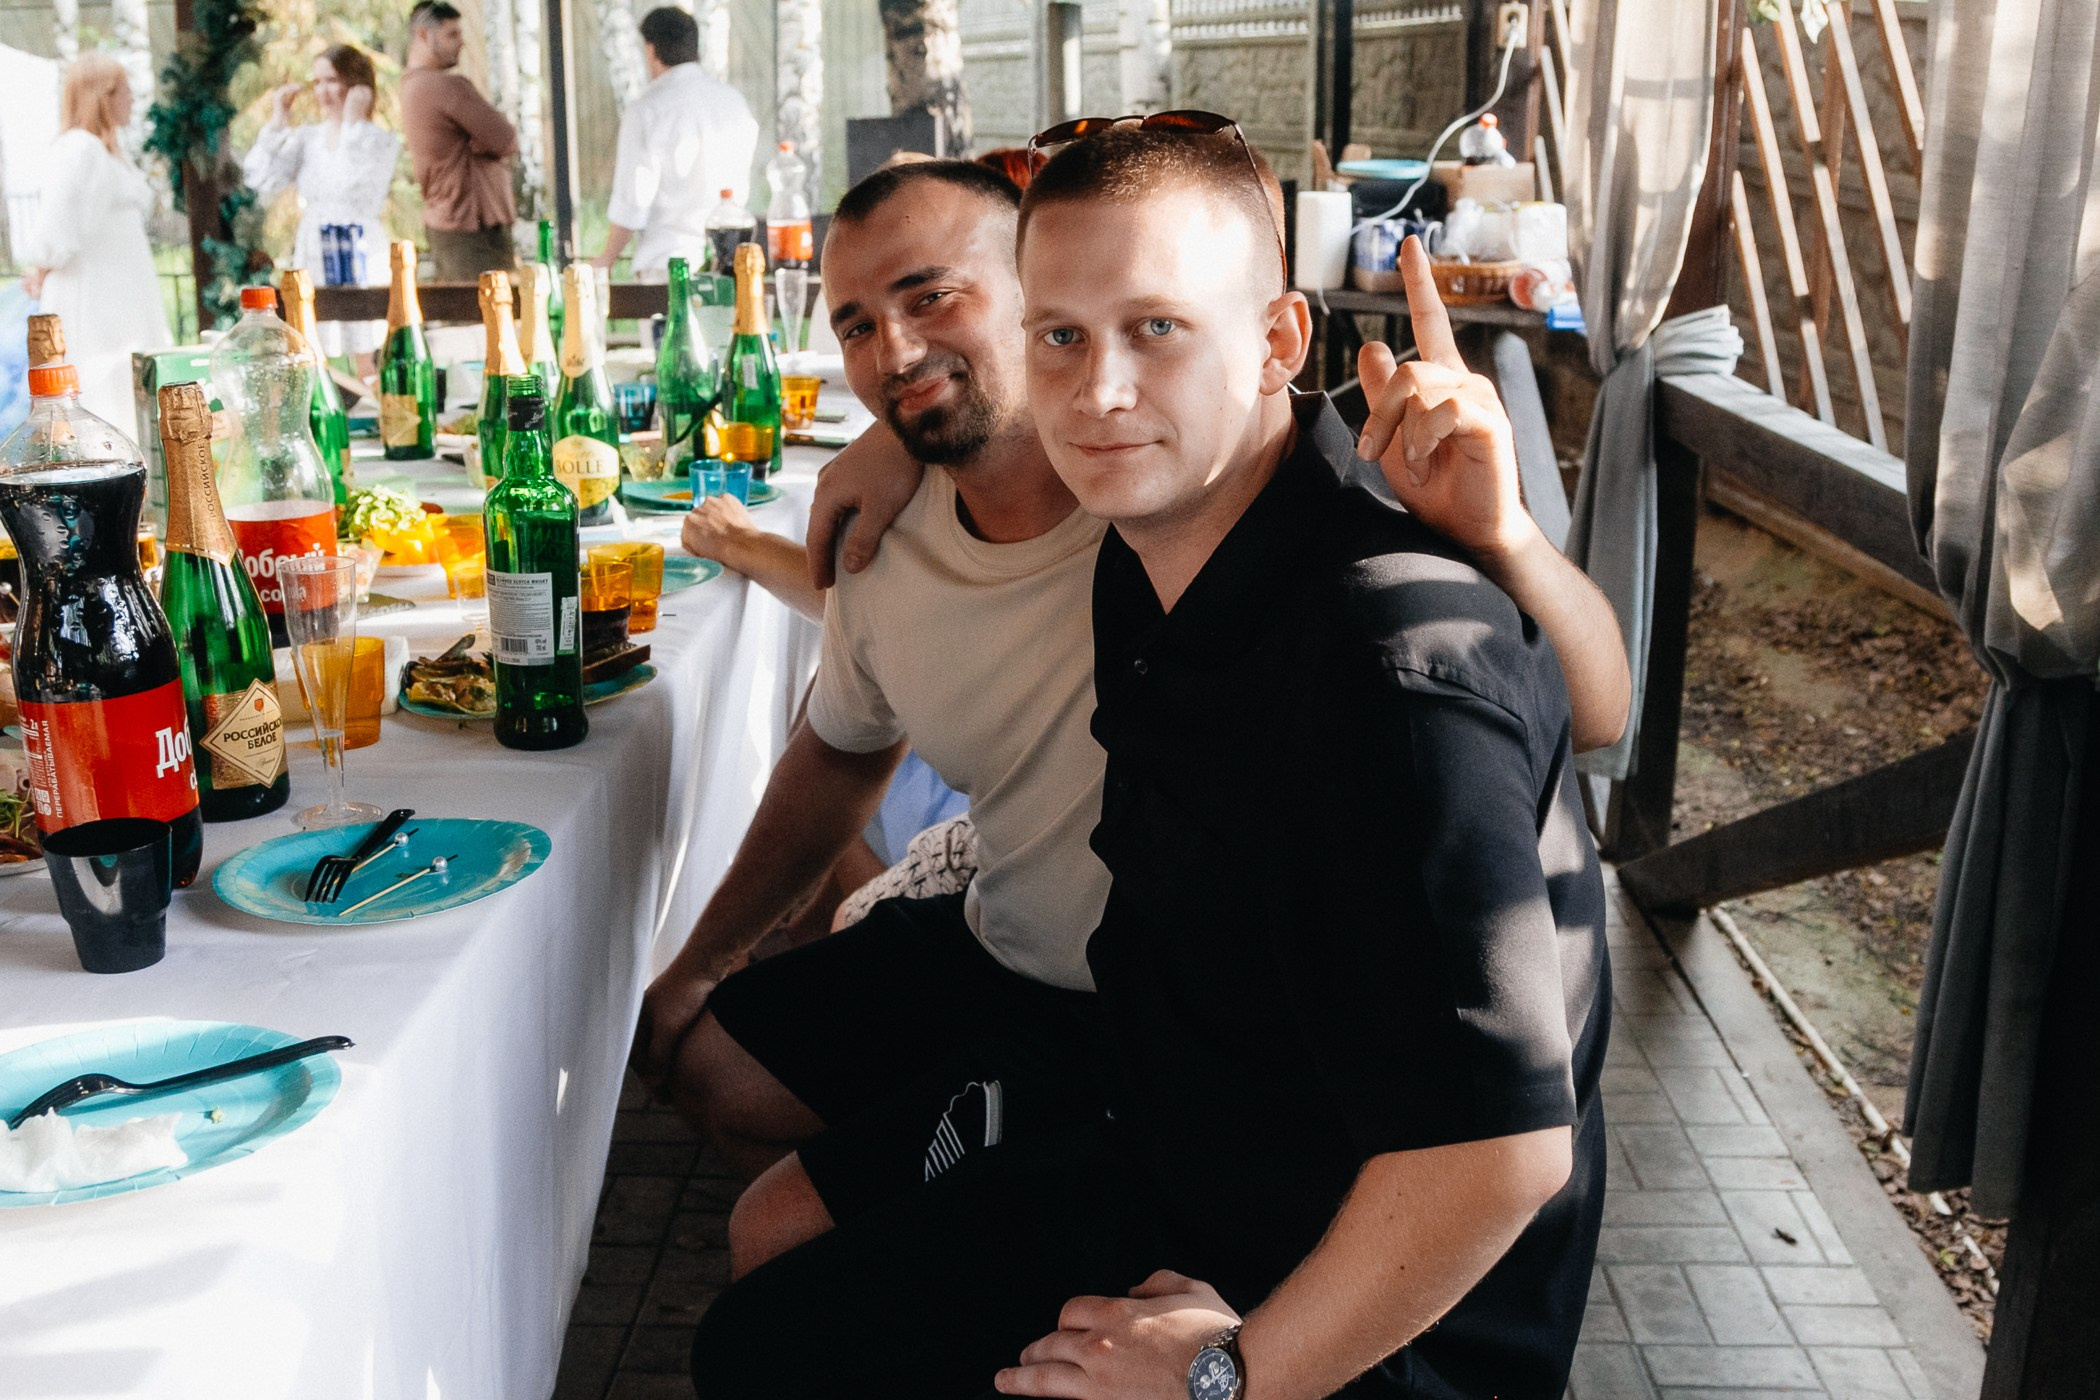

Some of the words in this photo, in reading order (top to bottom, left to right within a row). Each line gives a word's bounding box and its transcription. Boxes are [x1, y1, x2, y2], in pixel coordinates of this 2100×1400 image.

[198, 442, 217, 518] РОССИЙСКОЕ
[238, 542, 326, 582] обрый
[42, 720, 63, 818] ПЕРЕРАБАТЫВАЕМАЯ
[247, 732, 277, 750] БЕЛОЕ
